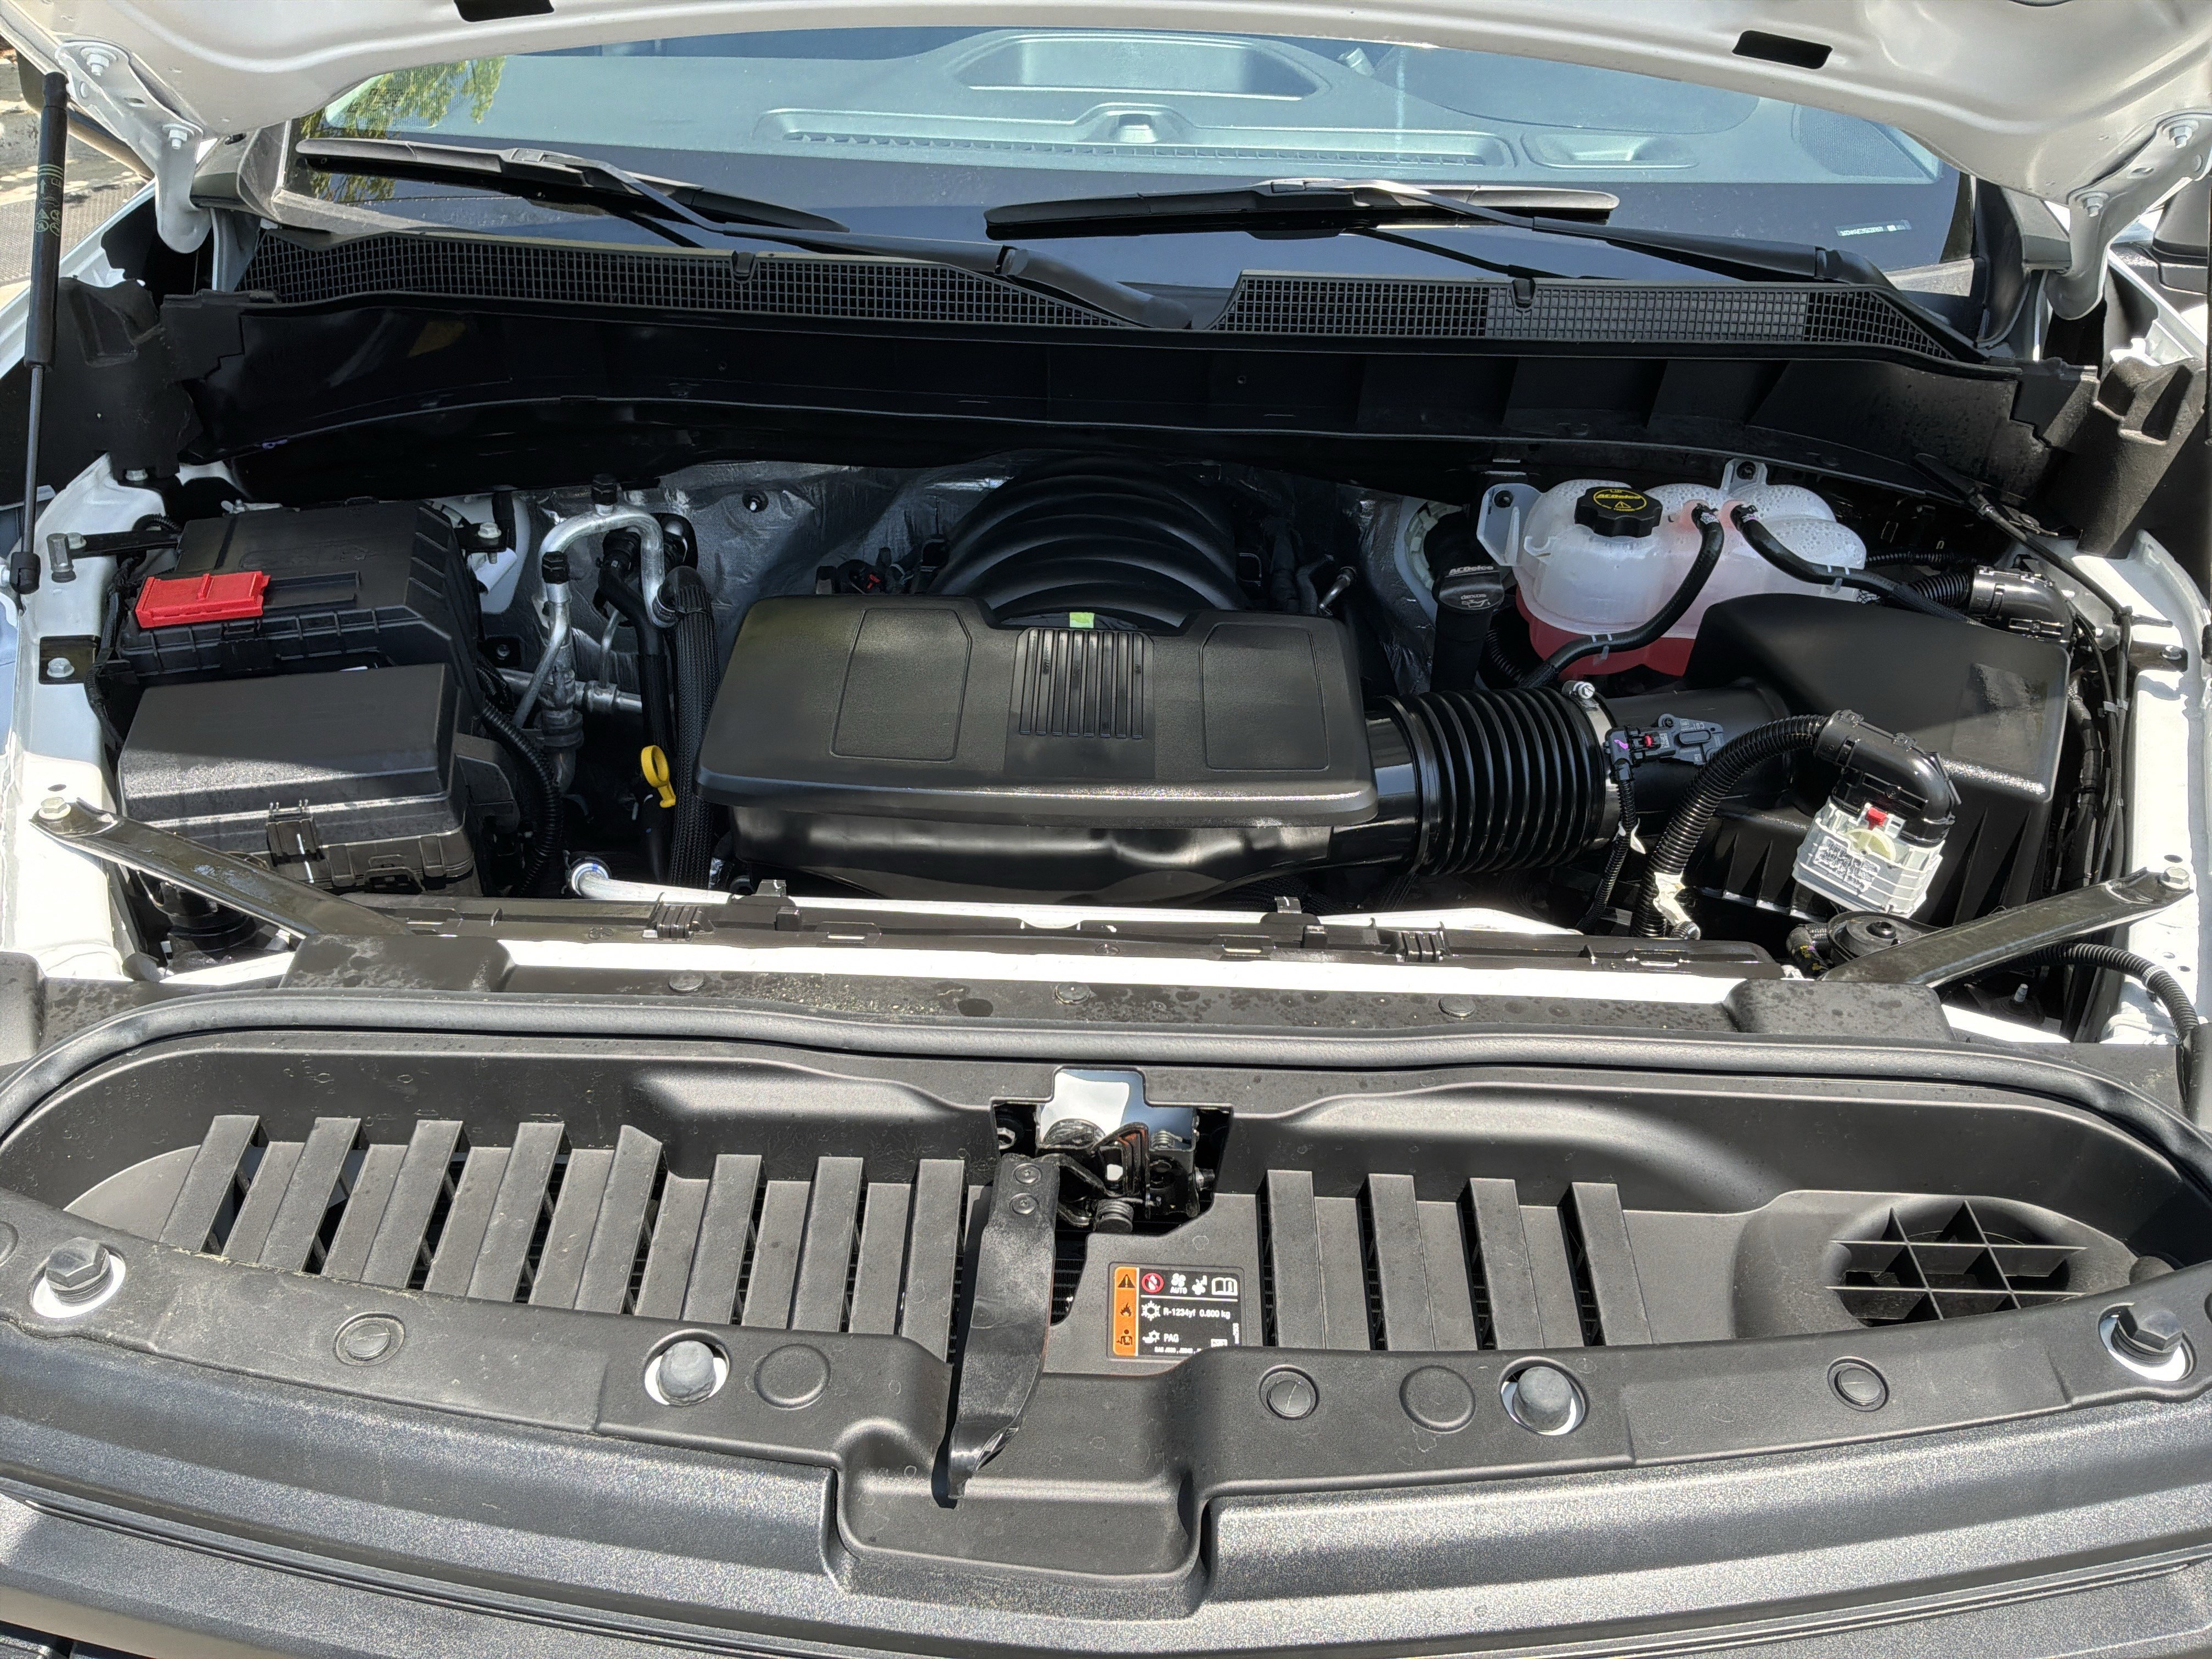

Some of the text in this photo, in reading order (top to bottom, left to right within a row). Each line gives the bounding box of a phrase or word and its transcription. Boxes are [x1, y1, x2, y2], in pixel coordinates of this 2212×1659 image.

[1449, 566, 1493, 575] ACDelco
[1163, 1307, 1195, 1318] R-1234yf
[1221, 1310, 1231, 1319] kg
[1164, 1333, 1179, 1342] PAG
